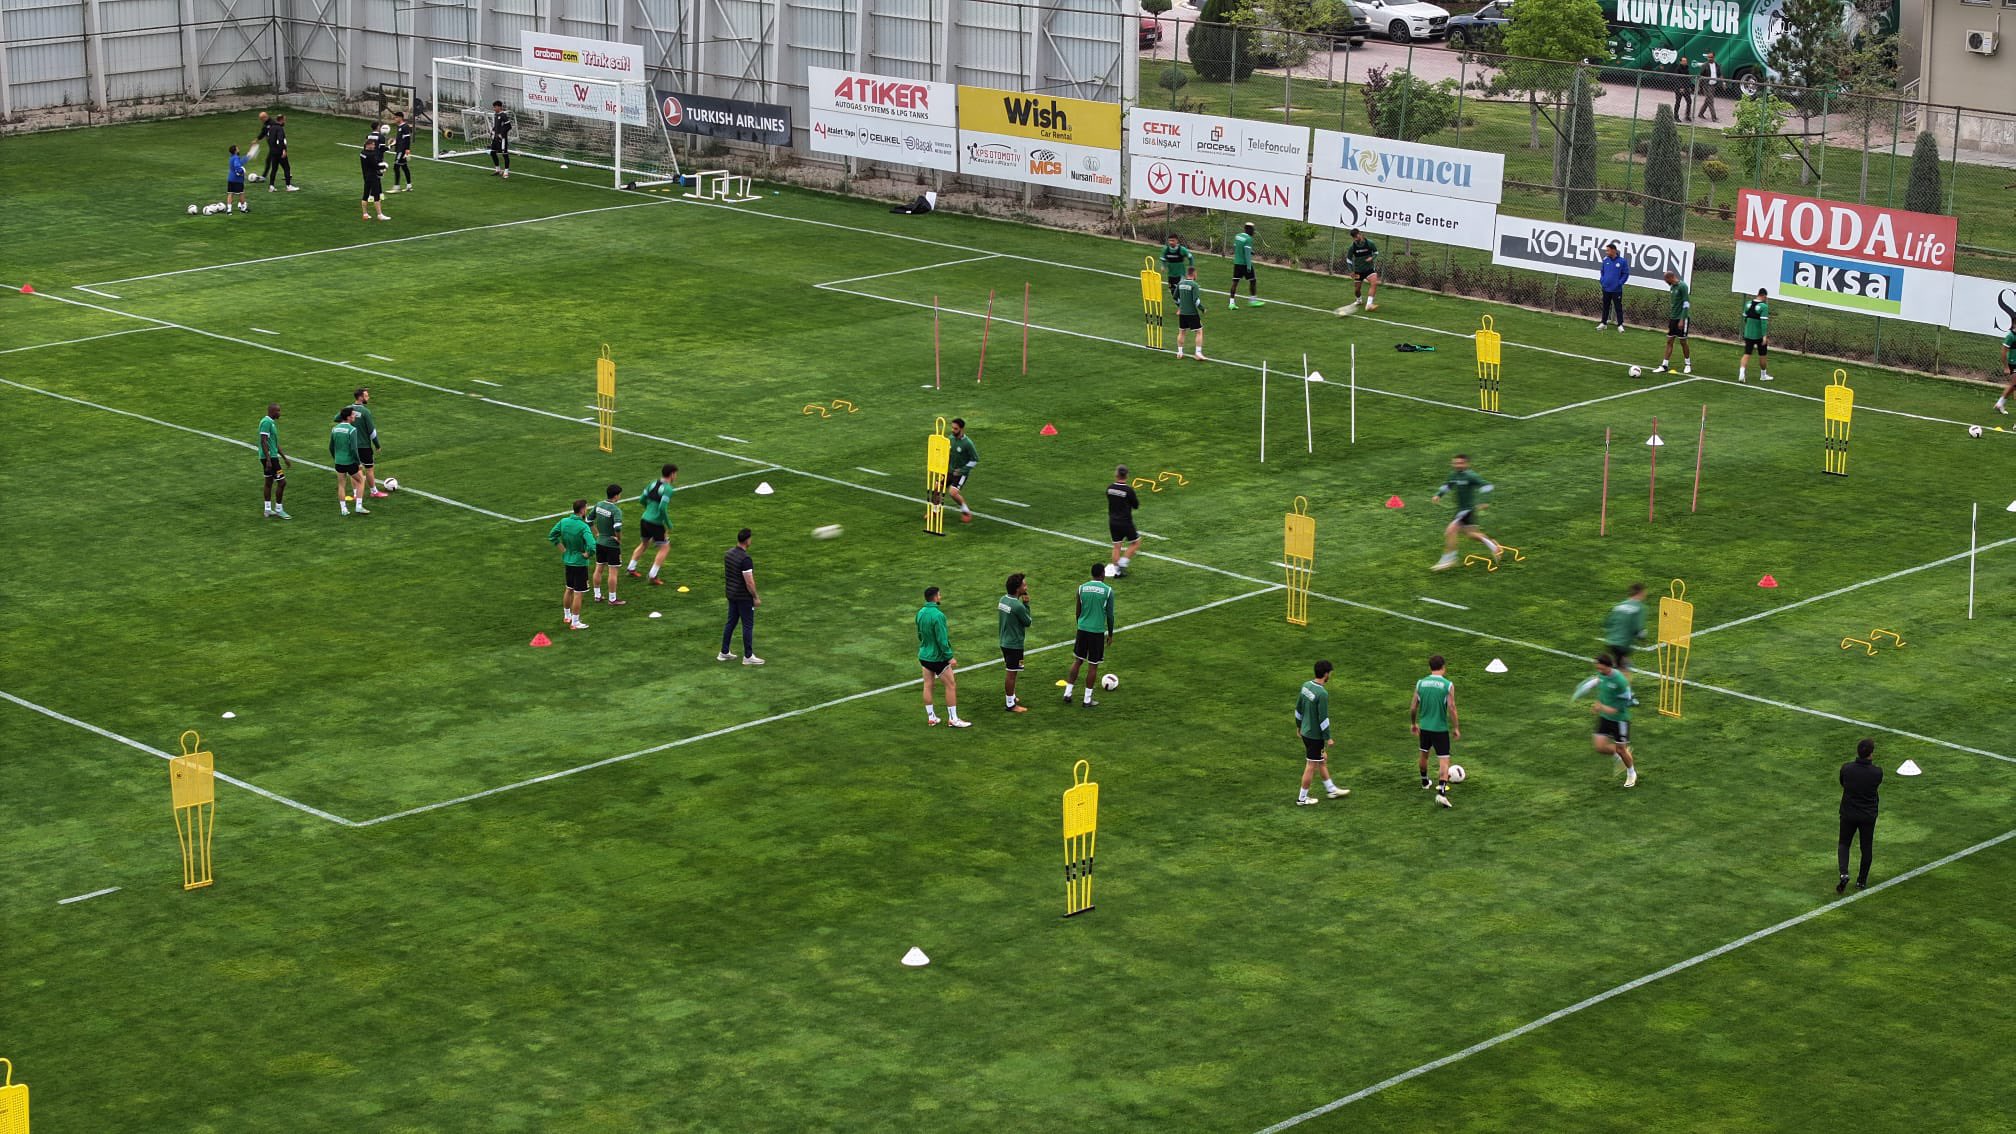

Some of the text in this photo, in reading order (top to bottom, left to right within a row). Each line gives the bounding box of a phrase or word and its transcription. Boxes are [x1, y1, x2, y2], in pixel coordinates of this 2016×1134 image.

[1617, 0, 1740, 35] KONYASPOR
[582, 50, 609, 69] Trink
[686, 107, 785, 132] TURKISH AIRLINES
[835, 100, 863, 111] AUTOGAS
[863, 104, 889, 115] SYSTEMS
[896, 109, 908, 117] LPG
[909, 111, 929, 119] TANKS
[1003, 97, 1067, 131] Wish
[1040, 129, 1073, 140] Car Rental
[1197, 141, 1236, 153] process
[1247, 138, 1301, 155] Telefoncular
[1029, 160, 1062, 175] MCS
[1340, 136, 1472, 188] koyuncu
[1070, 170, 1113, 185] NursanTrailer
[1177, 169, 1290, 208] TÜMOSAN
[1365, 205, 1459, 230] Sigorta Center
[1742, 193, 1946, 266] MODA Life
[1795, 262, 1887, 300] aksa
